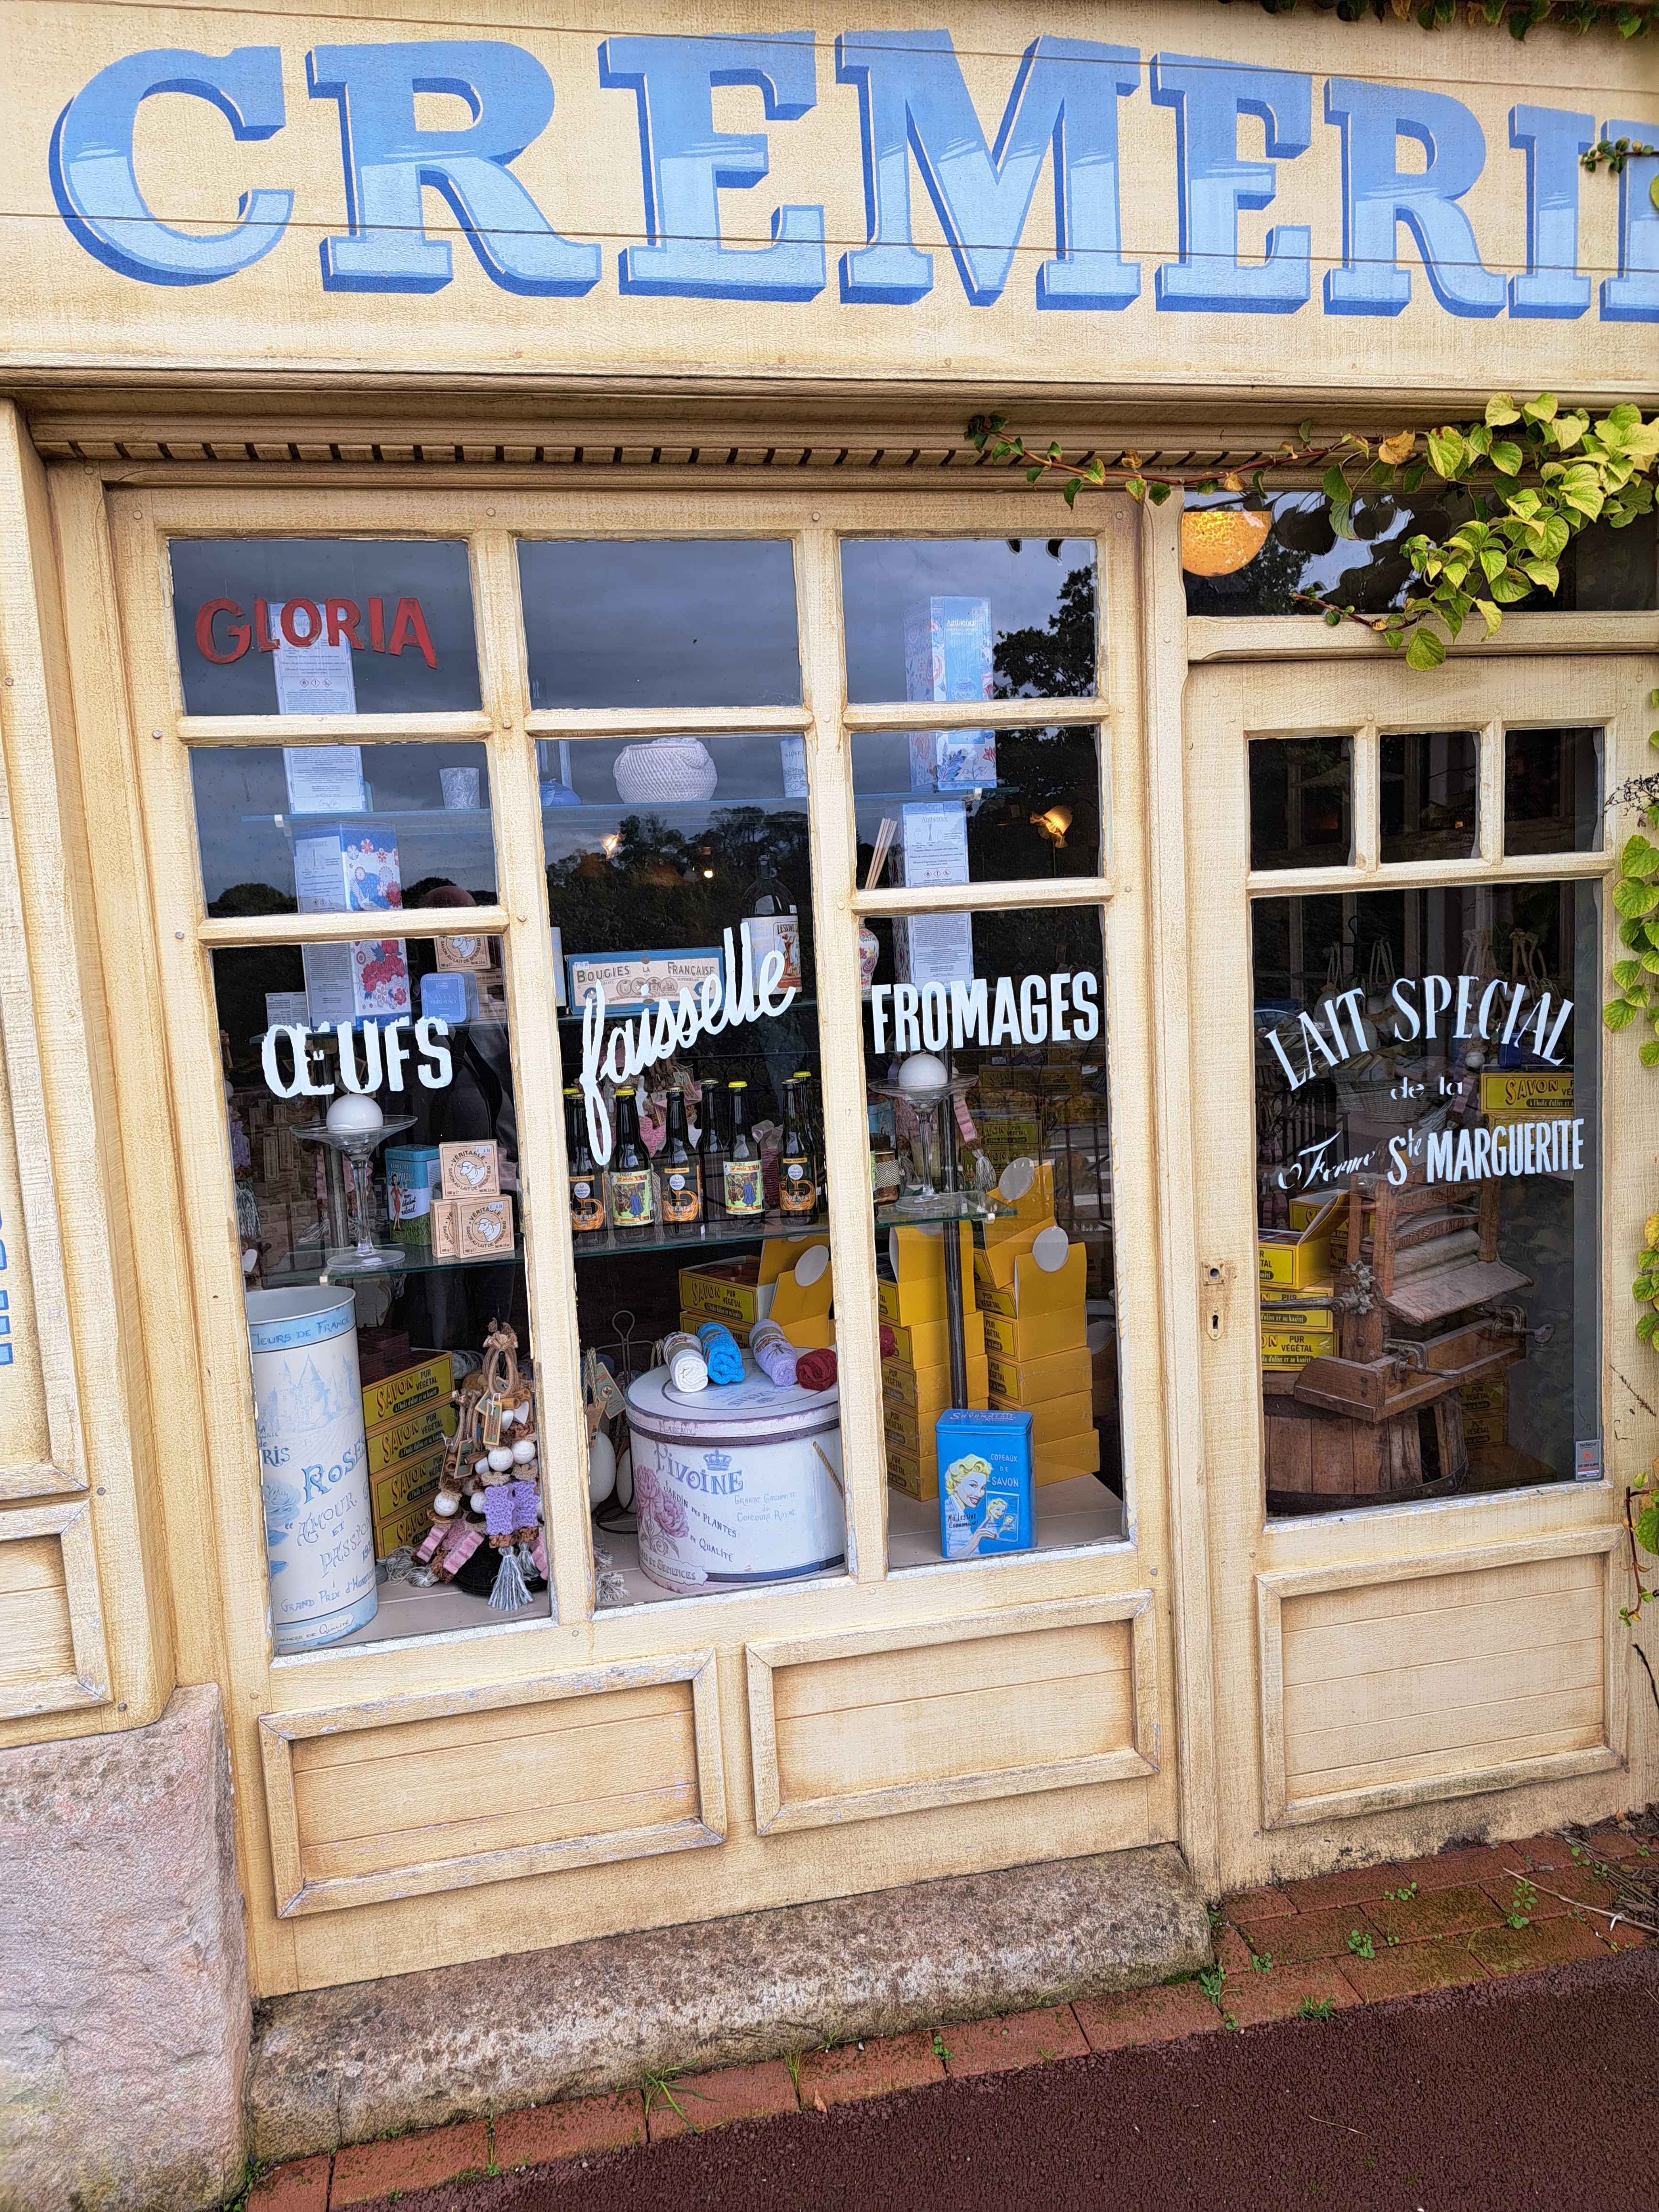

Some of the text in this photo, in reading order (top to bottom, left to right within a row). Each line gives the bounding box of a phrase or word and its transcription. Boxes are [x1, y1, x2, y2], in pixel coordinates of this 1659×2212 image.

[195, 597, 439, 670] GLORIA
[577, 965, 631, 983] BOUGIES
[667, 962, 715, 976] FRANÇAISE
[872, 971, 1098, 1054] FROMAGES
[1265, 974, 1574, 1091] LAIT SPECIAL
[579, 921, 796, 1166] faisselle
[261, 1016, 453, 1098] ŒUFS
[1391, 1076, 1463, 1100] de la
[1505, 1079, 1558, 1106] SAVON
[981, 1126, 1005, 1138] AVON
[1427, 1118, 1584, 1184] MARGUERITE
[692, 1280, 736, 1306] SAVON PUR
[982, 1292, 993, 1301] PUR
[981, 1299, 1002, 1309] VÉGÉTAL
[296, 1329, 311, 1339] DE
[316, 1316, 350, 1334] FRANCE
[986, 1319, 995, 1329] PUR
[732, 1332, 743, 1341] PUR
[985, 1328, 1001, 1340] ÉGÉTAL
[1281, 1343, 1314, 1353] VÉGÉTAL
[889, 1368, 897, 1378] PUR
[991, 1362, 1000, 1371] PUR
[415, 1375, 438, 1391] VÉGÉTAL
[885, 1376, 902, 1389] VÉGÉTAL
[376, 1369, 431, 1417] SAVON PUR
[890, 1411, 899, 1421] PUR
[421, 1419, 443, 1435] VÉGÉTAL
[886, 1418, 905, 1432] VÉGÉTAL
[382, 1412, 437, 1463] SAVON PUR
[263, 1446, 290, 1467] RIS
[892, 1455, 900, 1465] PUR
[991, 1454, 1018, 1462] COPEAUX
[429, 1464, 442, 1477] VÉGÉ
[654, 1441, 744, 1495] PIVOINE
[391, 1463, 427, 1507] SAVON
[433, 1454, 443, 1466] PUR
[992, 1477, 1019, 1488] SAVON
[664, 1480, 689, 1508] JARDIN
[702, 1512, 737, 1538] PLANTES
[734, 1495, 761, 1507] GRANDE
[737, 1509, 797, 1523] CONCOURS ROYAL
[332, 1521, 345, 1537] ET
[690, 1535, 734, 1563] DE QUALITÉ
[281, 1599, 315, 1613] GRAND
[318, 1590, 341, 1604] PRIX
[319, 1619, 350, 1635] QUALITÉ
